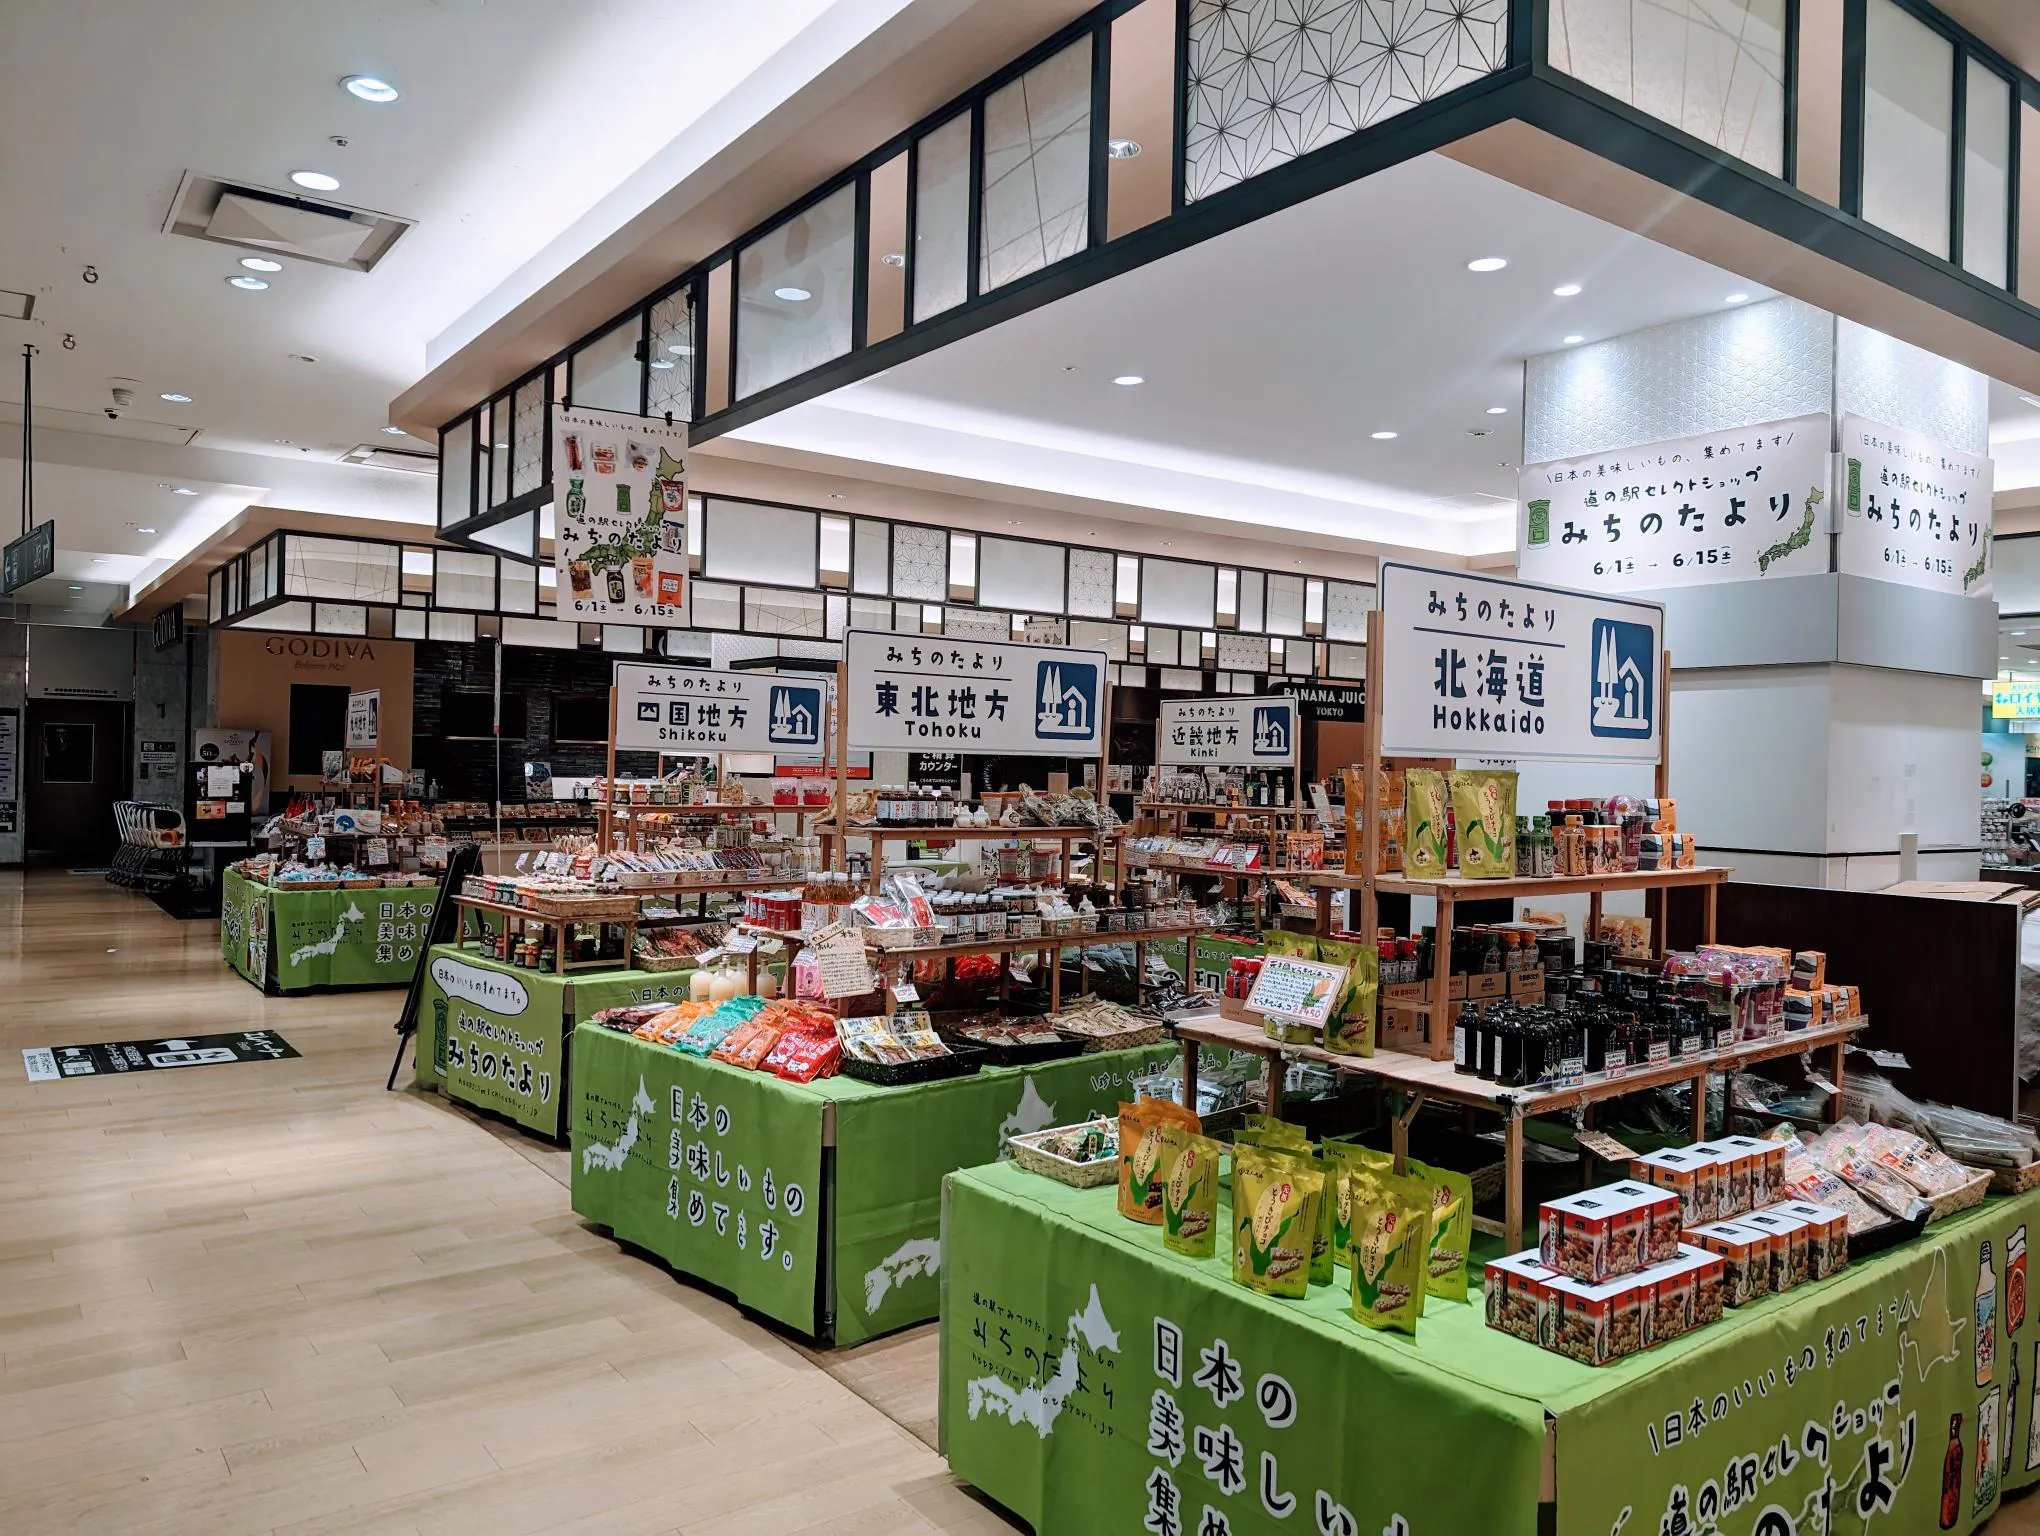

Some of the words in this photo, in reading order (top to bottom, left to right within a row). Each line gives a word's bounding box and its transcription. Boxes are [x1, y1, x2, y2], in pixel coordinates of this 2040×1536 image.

[1584, 465, 1763, 508] 道の駅セレクトショップ
[1562, 493, 1791, 545] みちのたより
[1867, 494, 1978, 547] みちのたより
[562, 526, 683, 552] みちのたより
[1427, 589, 1557, 633] みちのたより
[265, 636, 376, 661] GODIVA
[887, 646, 1003, 671] みちのたより
[648, 674, 742, 693] みちのたより
[1434, 648, 1546, 708] 北海道
[875, 680, 1009, 722] 東北地方
[1283, 687, 1336, 704] BANANA
[637, 701, 748, 731] 四国地方
[1178, 706, 1235, 718] みちのたより
[1316, 706, 1344, 717] TOKYO
[1432, 704, 1546, 736] Hokkaido
[659, 727, 727, 743] Shikoku
[904, 721, 982, 739] Tohoku
[1172, 726, 1239, 746] 近畿地方
[919, 760, 958, 772] カウンター
[1190, 748, 1219, 758] Kinki
[449, 1039, 550, 1102] みちのたより
[672, 1089, 729, 1133] 日本の
[1259, 1187, 1279, 1245] とうきびチョコ
[1368, 1216, 1384, 1277] とうきびチョコ
[1158, 1321, 1292, 1421] 日本の
